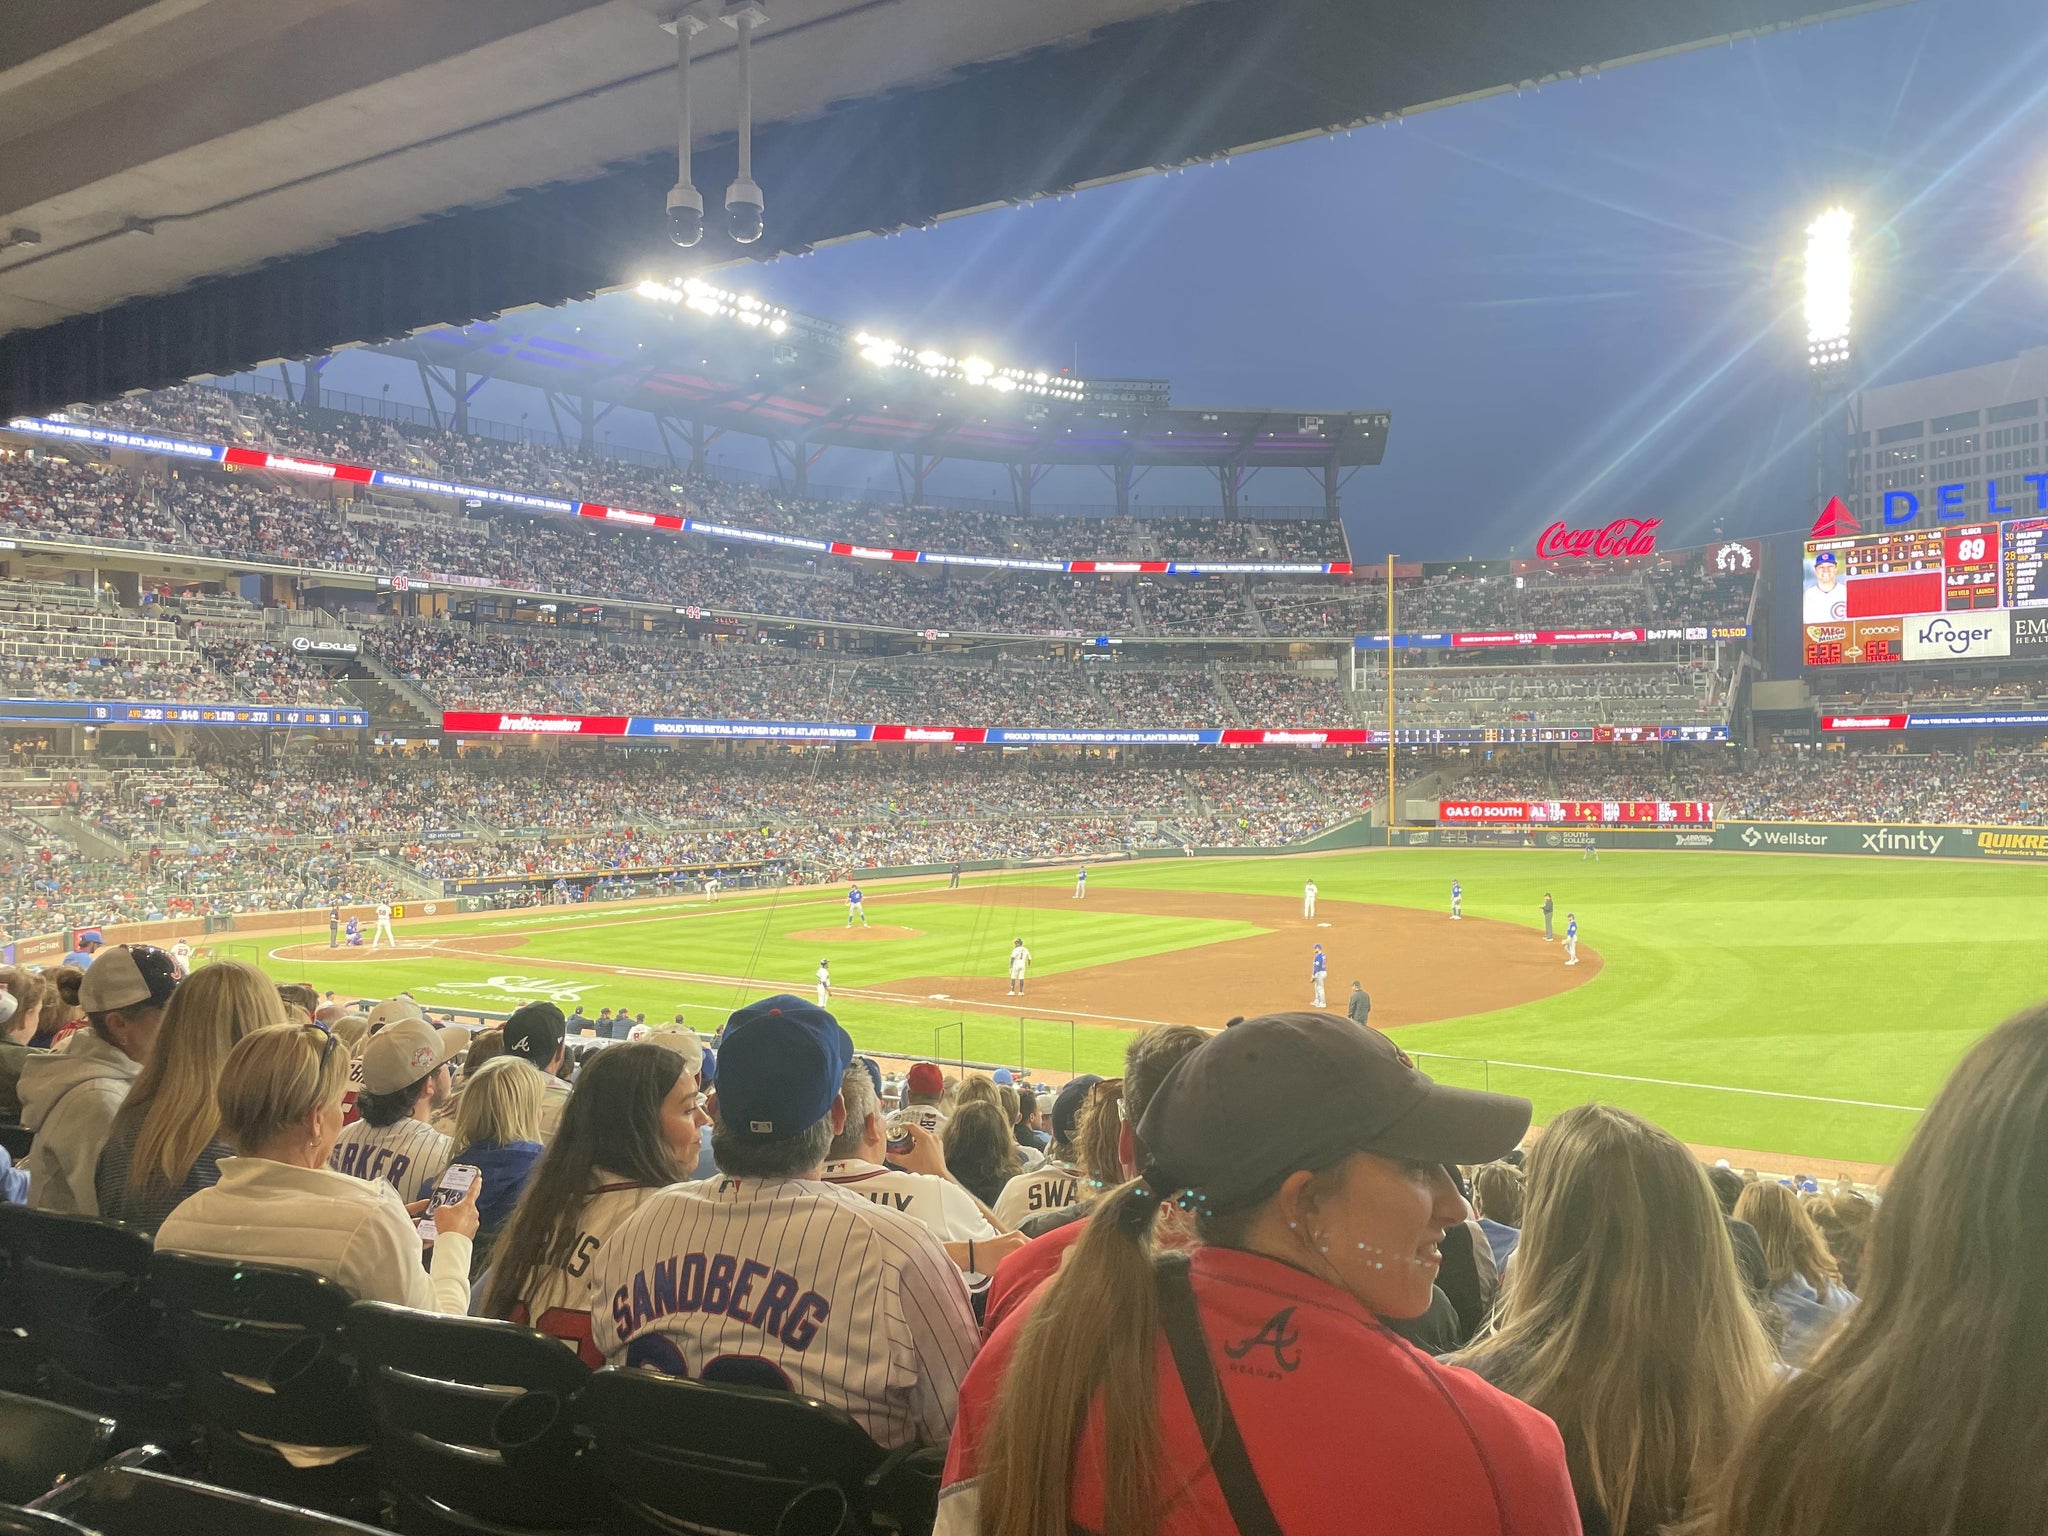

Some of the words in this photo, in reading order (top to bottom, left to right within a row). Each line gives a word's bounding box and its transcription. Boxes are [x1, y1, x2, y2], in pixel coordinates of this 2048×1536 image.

[129, 436, 174, 451] ATLANTA
[1958, 538, 1986, 561] 89
[2004, 551, 2016, 561] 28
[392, 576, 408, 590] 41
[686, 606, 700, 619] 44
[1667, 629, 1682, 639] PM
[1711, 627, 1747, 639] $10,500
[2015, 618, 2048, 636] EM
[1919, 618, 1993, 654] Kroger
[310, 641, 358, 651] LEXUS
[1808, 643, 1841, 658] 232
[1866, 641, 1889, 656] 69
[1808, 657, 1841, 665] MILLION
[1866, 654, 1901, 663] MILLION
[1452, 679, 1499, 697] HANK
[1508, 679, 1575, 697] AARON
[1580, 677, 1675, 695] TERRACE
[204, 711, 215, 719] OPS
[287, 712, 299, 723] 47
[353, 714, 363, 724] 14
[654, 722, 684, 734] PROUD
[685, 724, 704, 734] TIRE
[705, 725, 732, 735] RETAIL
[733, 725, 769, 735] PARTNER
[769, 726, 780, 735] OF
[781, 727, 796, 736] THE
[796, 727, 829, 737] ATLANTA
[830, 728, 857, 737] BRAVES
[1004, 732, 1030, 741] PROUD
[1048, 733, 1071, 741] RETAIL
[1072, 733, 1105, 742] PARTNER
[1131, 733, 1168, 742] ATLANTA
[1168, 733, 1200, 742] BRAVES
[1446, 807, 1470, 816] GAS
[1484, 807, 1523, 817] SOUTH
[1530, 806, 1546, 817] AL
[1764, 831, 1828, 847] Wellstar
[1862, 828, 1945, 854] xfinity
[613, 1252, 830, 1352] SANDBERG
